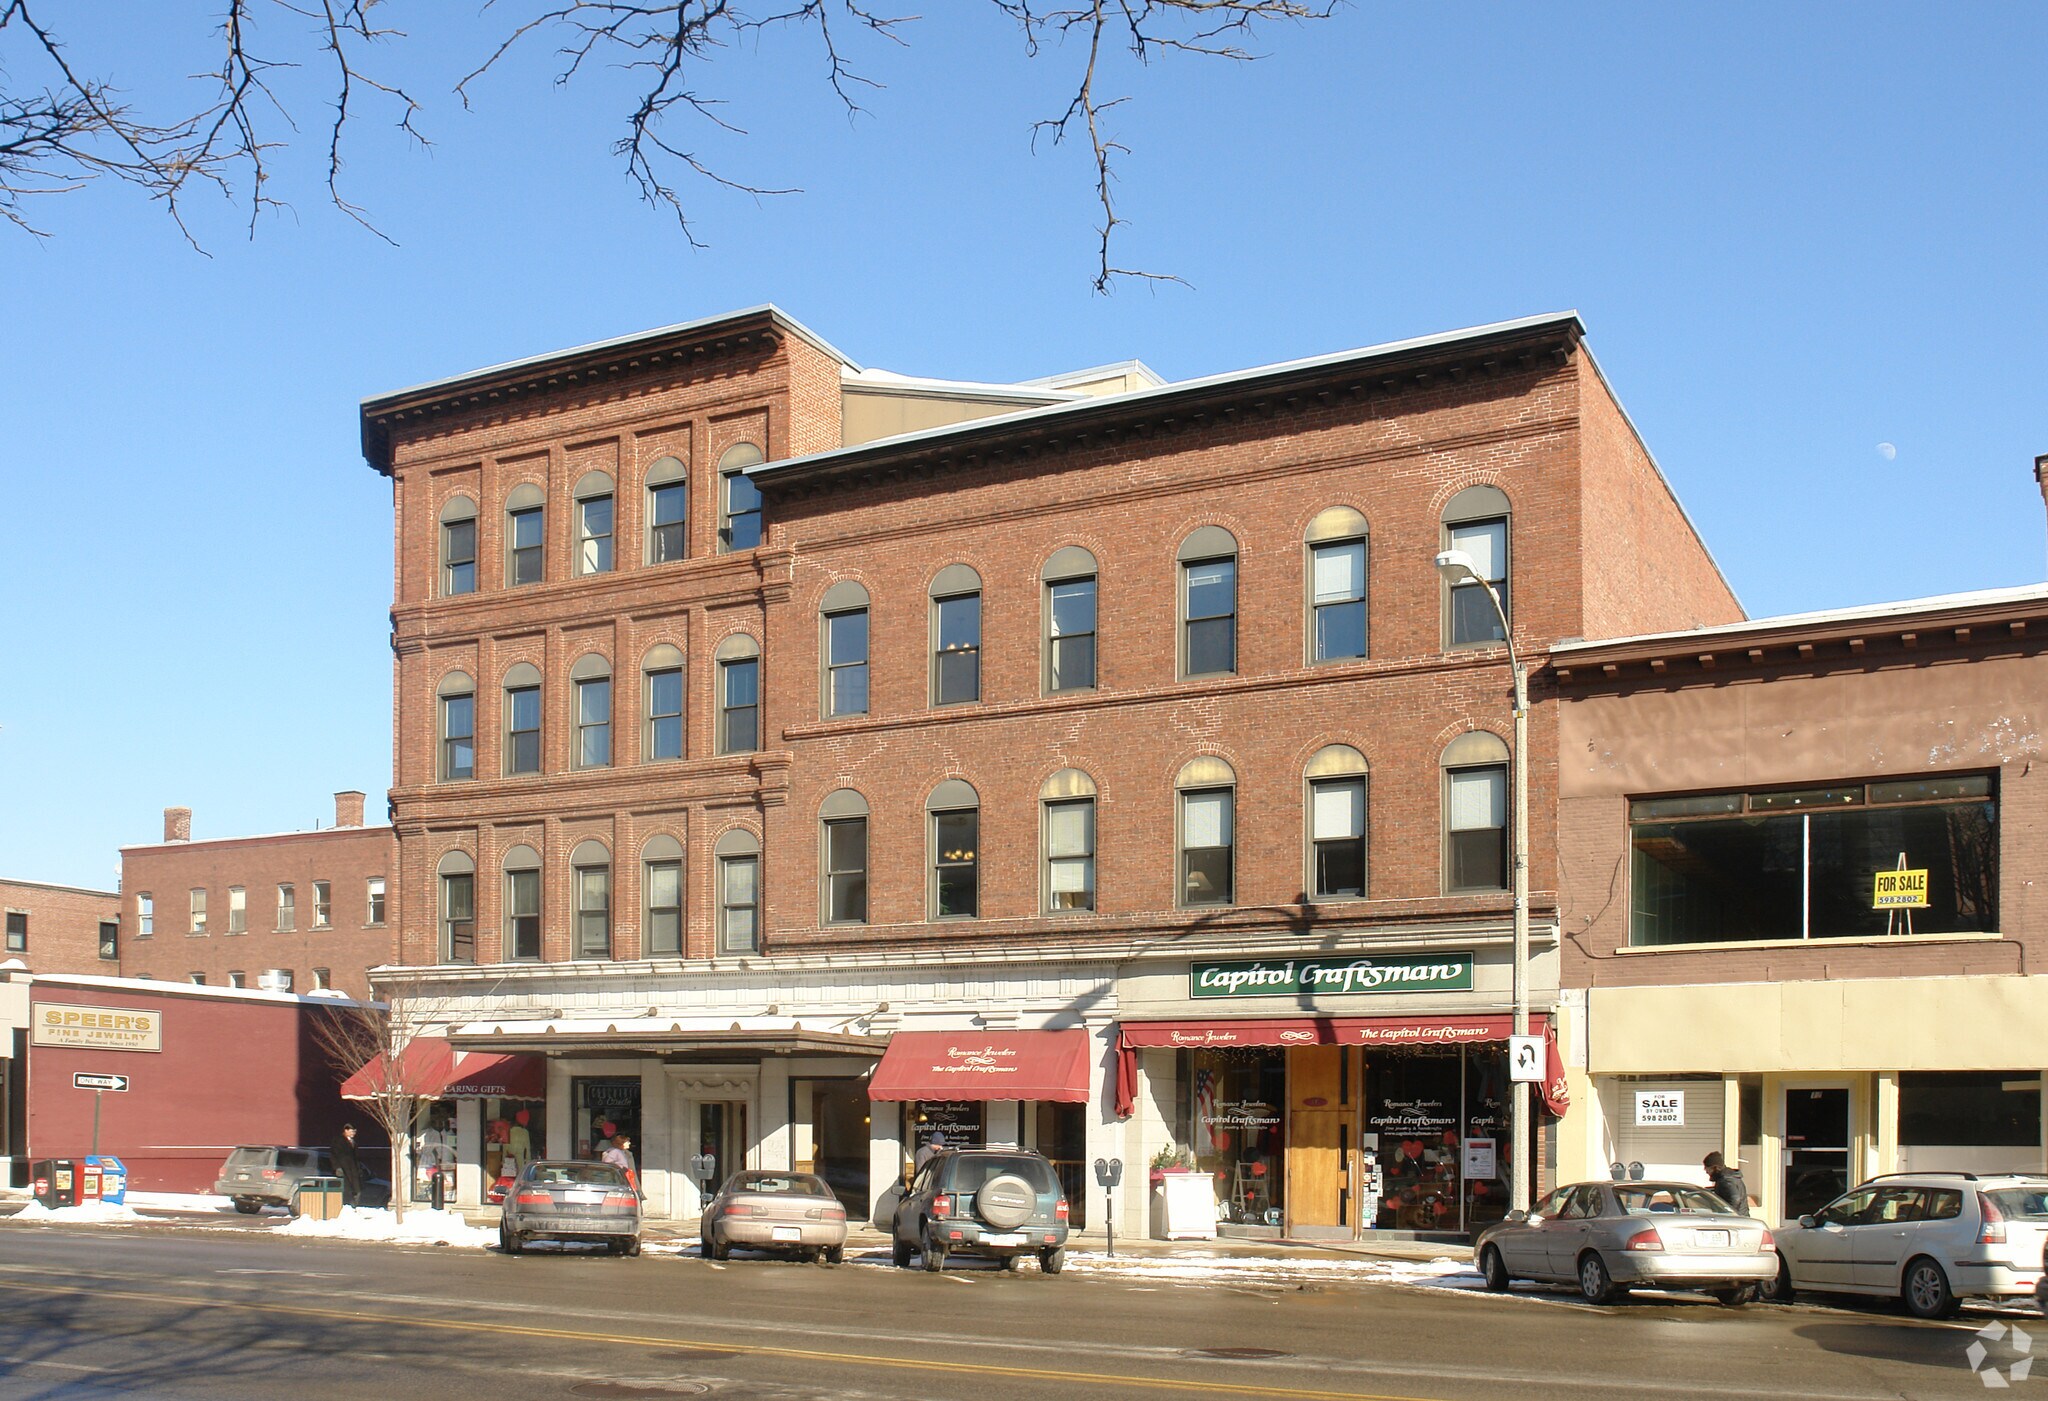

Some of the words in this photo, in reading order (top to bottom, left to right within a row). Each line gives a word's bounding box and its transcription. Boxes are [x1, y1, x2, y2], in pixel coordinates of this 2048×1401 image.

[1878, 877, 1896, 892] FOR
[1899, 875, 1924, 891] SALE
[1200, 961, 1295, 994] Capitol
[1299, 960, 1463, 992] Craftsman
[46, 1011, 150, 1030] SPEER'S
[48, 1028, 79, 1036] FINE
[87, 1031, 147, 1040] JEWELRY
[1171, 1031, 1204, 1044] Romance
[1204, 1030, 1237, 1044] Jewelers
[1360, 1029, 1378, 1038] The
[1380, 1027, 1421, 1040] Capitol
[1421, 1026, 1489, 1039] Craftsman
[947, 1047, 982, 1058] Romance
[981, 1046, 1016, 1058] Jewelers
[945, 1065, 972, 1073] Capitol
[972, 1065, 1018, 1073] Craftsman
[444, 1085, 478, 1093] CARING
[480, 1085, 506, 1093] GIFTS
[921, 1103, 943, 1113] Romance
[945, 1103, 970, 1113] Jewelers
[1213, 1099, 1239, 1108] Romance
[1240, 1099, 1266, 1109] Jewelers
[1384, 1099, 1413, 1109] Romance
[1415, 1099, 1442, 1109] Jewelers
[1642, 1100, 1678, 1108] SALE
[1201, 1115, 1231, 1124] Capitol
[1231, 1115, 1280, 1126] Craftsman
[1370, 1115, 1402, 1126] Capitol
[1403, 1115, 1456, 1126] Craftsman
[911, 1122, 937, 1133] Capitol
[937, 1122, 980, 1133] Craftsman
